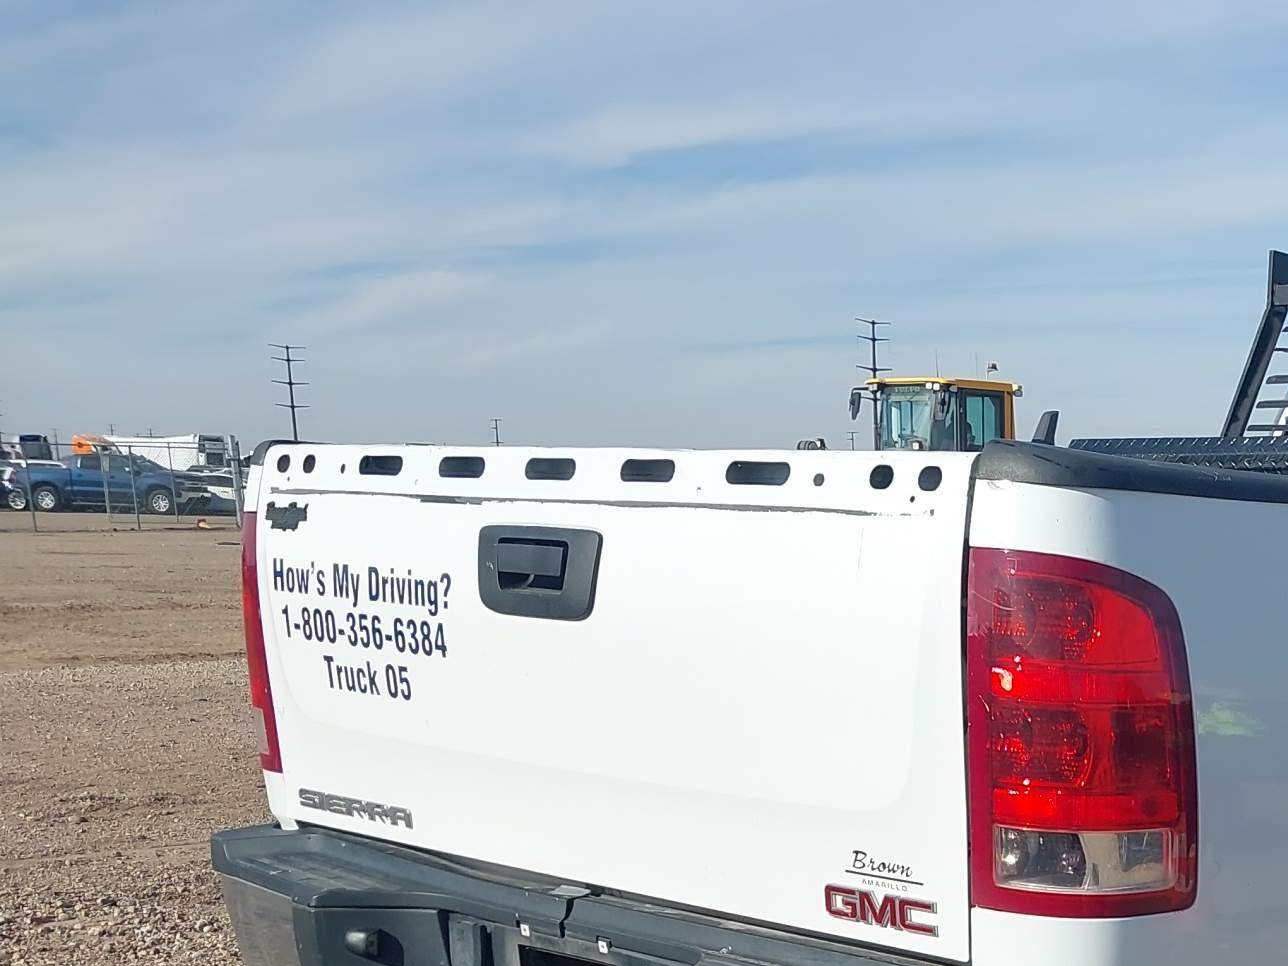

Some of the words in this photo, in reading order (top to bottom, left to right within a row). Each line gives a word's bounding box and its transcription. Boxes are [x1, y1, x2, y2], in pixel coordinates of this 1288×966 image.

[273, 557, 326, 597] How's
[332, 562, 360, 608] My
[367, 566, 452, 617] Driving?
[281, 604, 448, 659] 1-800-356-6384
[322, 654, 381, 696] Truck
[385, 663, 412, 701] 05
[298, 787, 414, 830] SIERRA
[851, 849, 913, 879] Brown
[861, 878, 908, 893] AMARILLO
[824, 883, 940, 939] GMC
